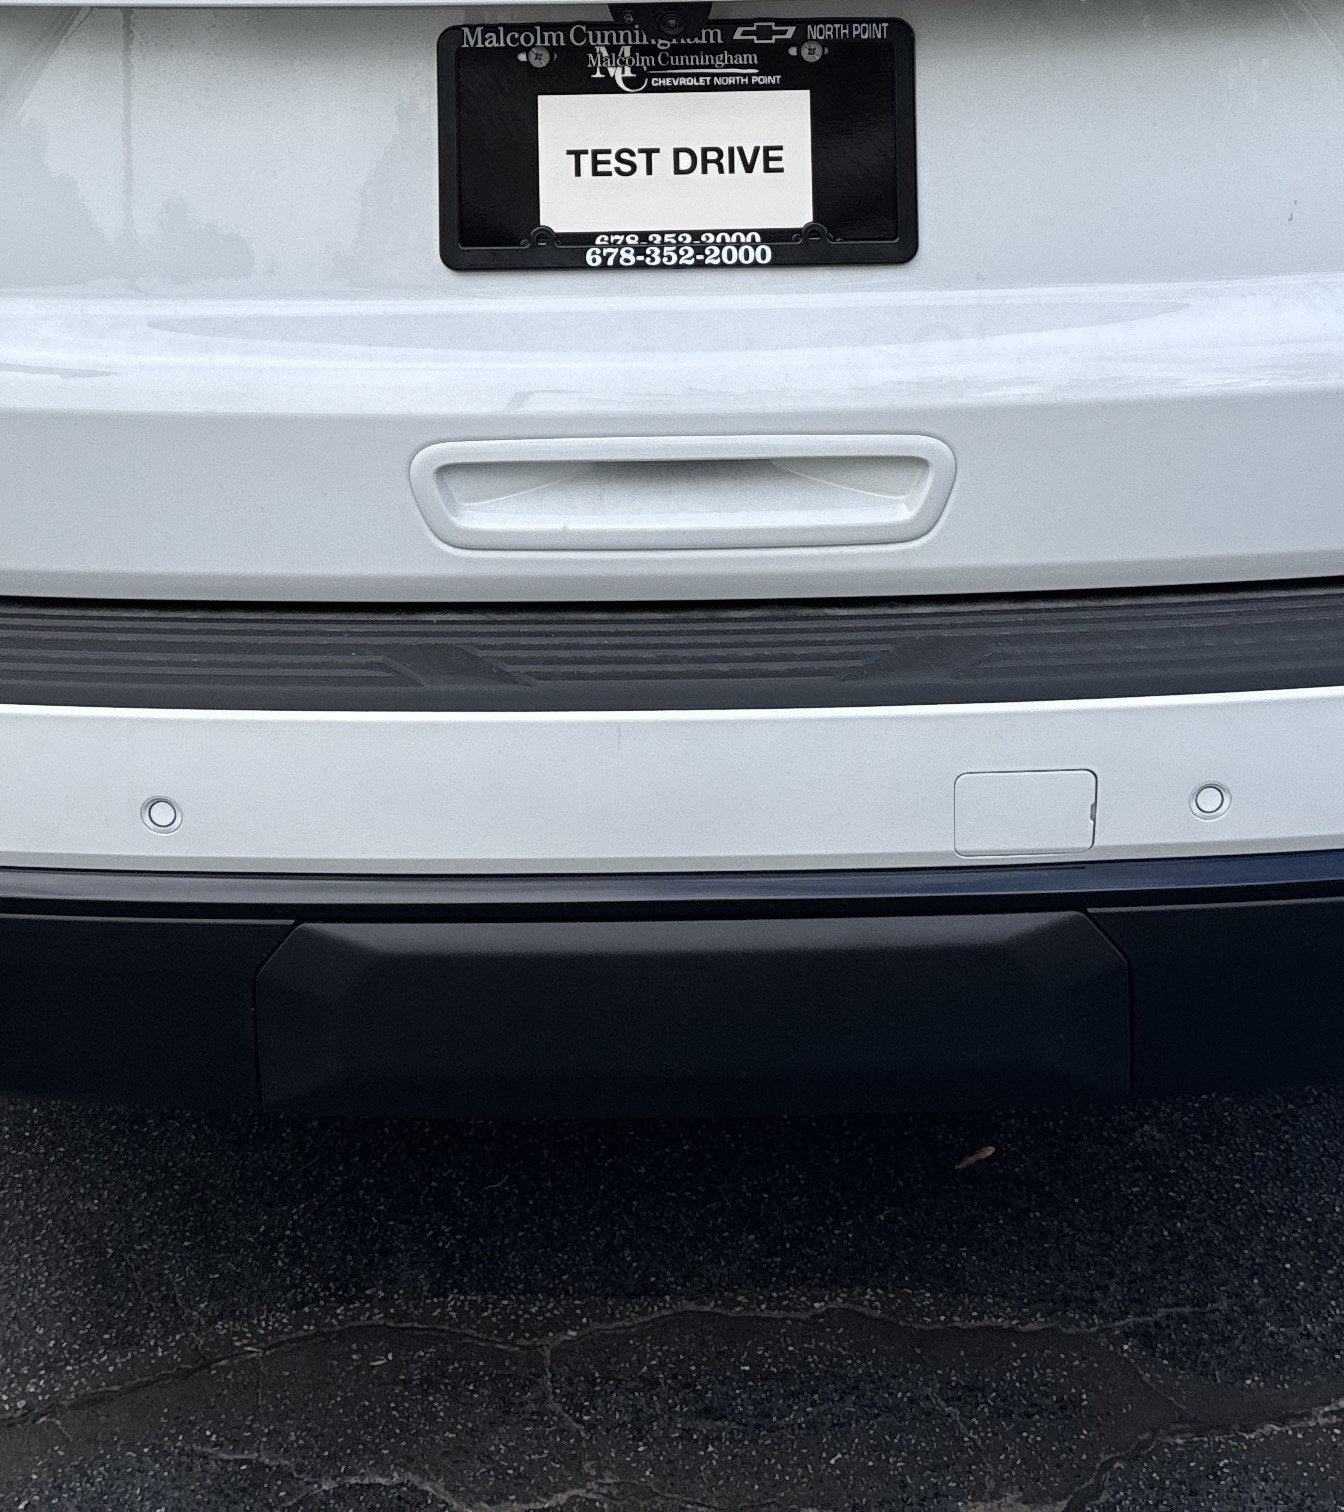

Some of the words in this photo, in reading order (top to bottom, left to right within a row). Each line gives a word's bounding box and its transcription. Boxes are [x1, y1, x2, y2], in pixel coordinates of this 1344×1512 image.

[460, 25, 565, 48] Malcolm
[807, 24, 850, 40] NORTH
[852, 22, 889, 39] POINT
[587, 52, 656, 68] Malcolm
[658, 50, 759, 69] Cunningham
[651, 76, 711, 87] CHEVROLET
[714, 76, 749, 86] NORTH
[751, 75, 782, 85] POINT
[566, 147, 660, 178] TEST
[673, 145, 785, 176] DRIVE
[585, 244, 772, 267] 678-352-2000
